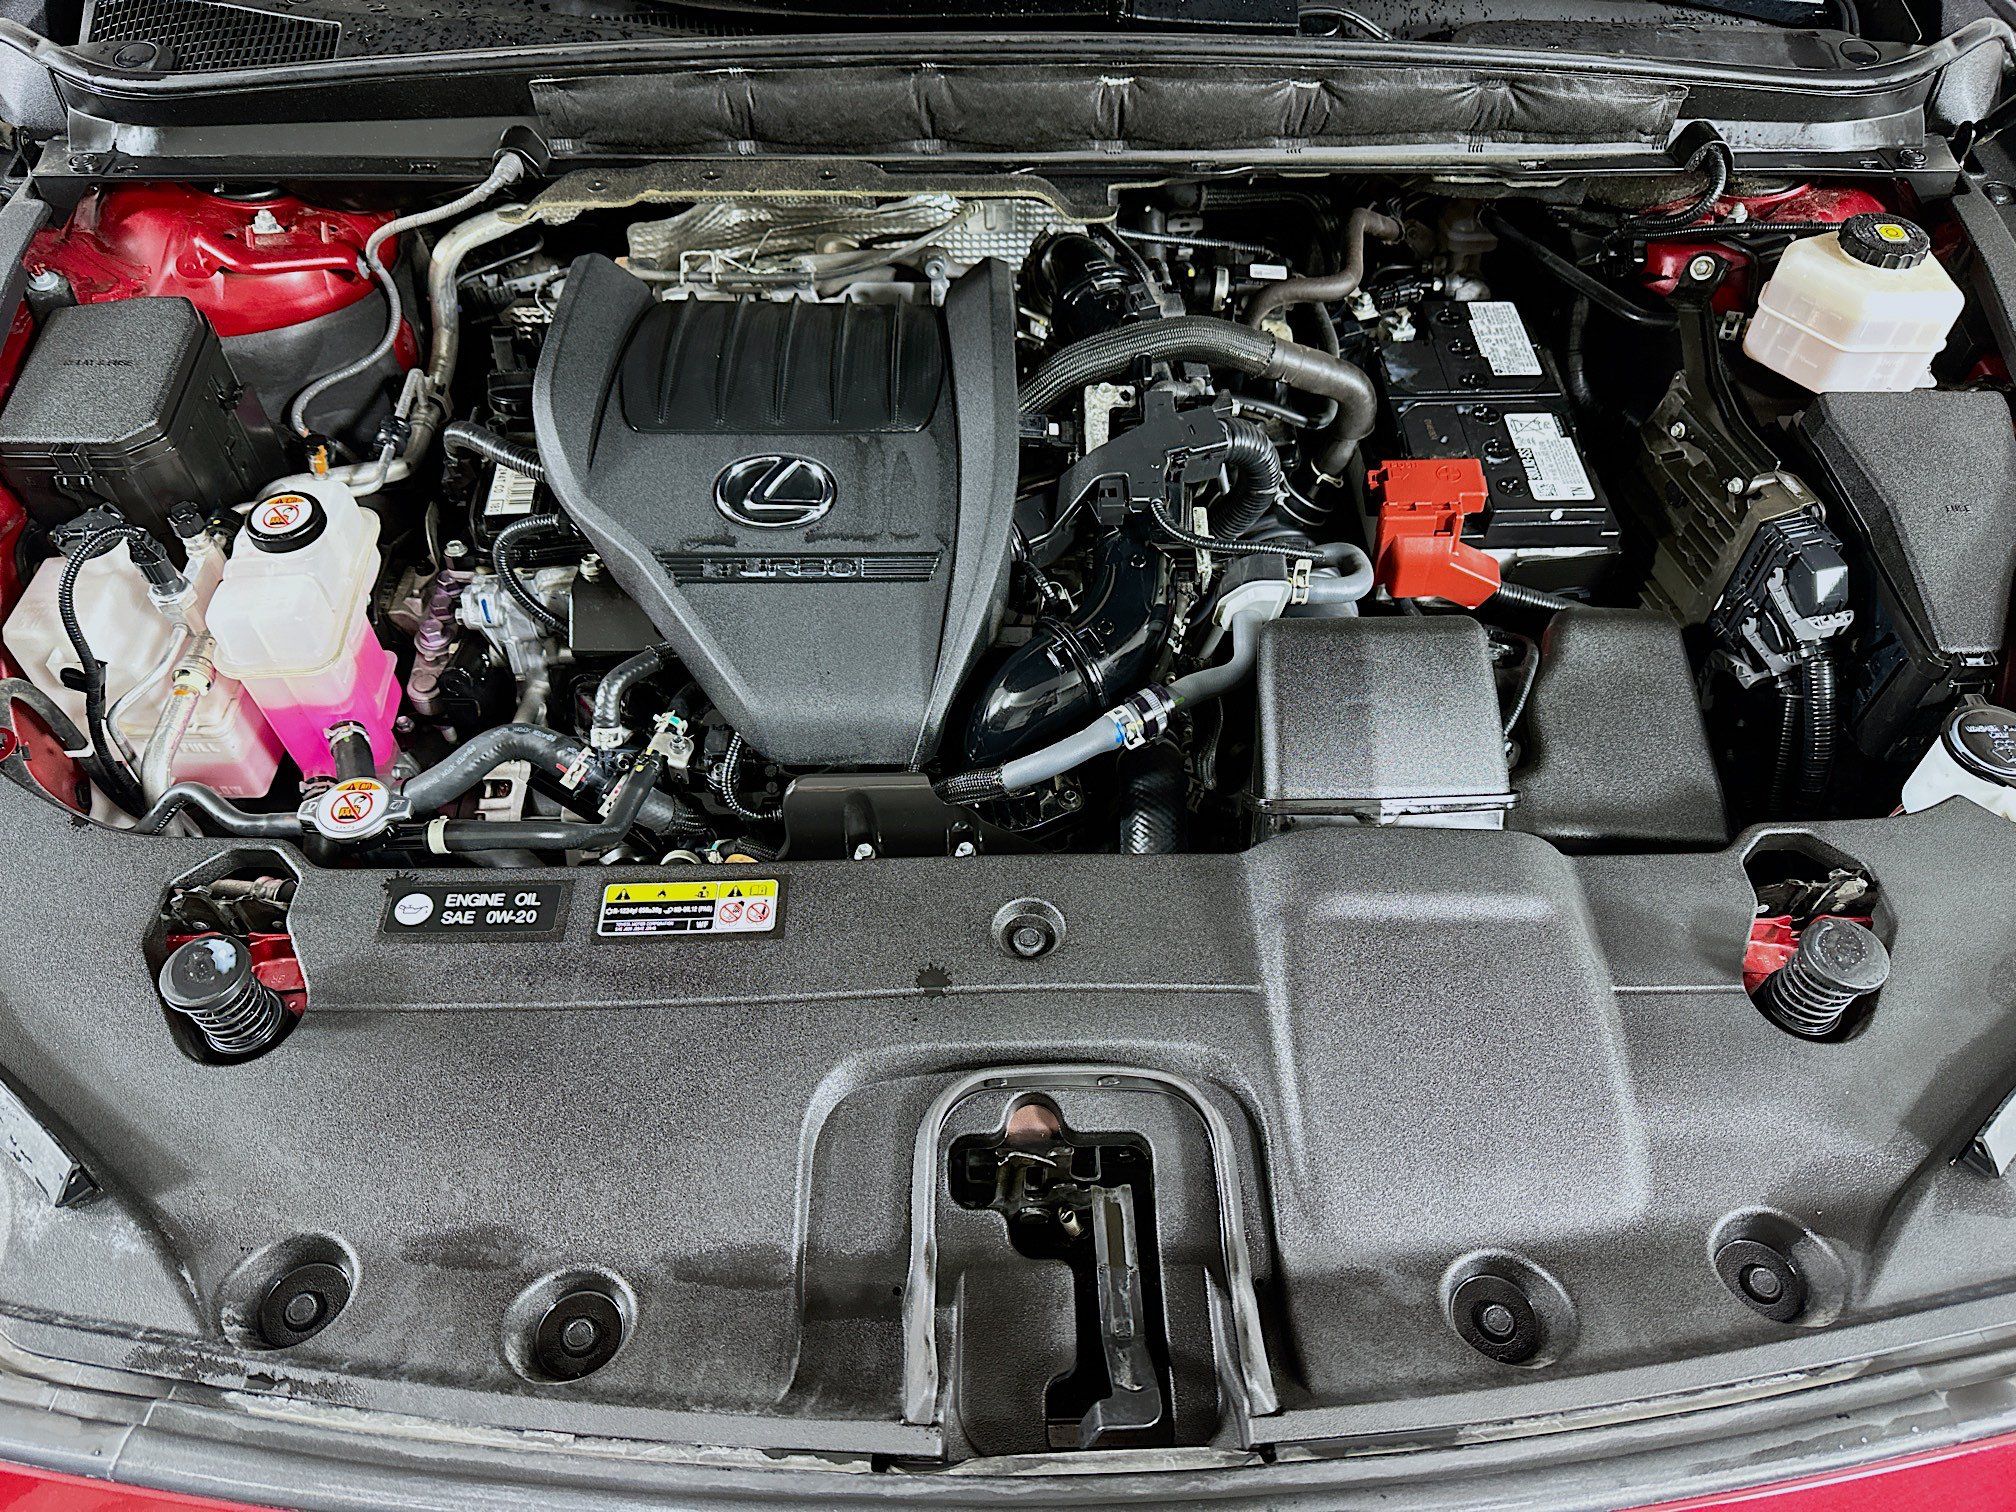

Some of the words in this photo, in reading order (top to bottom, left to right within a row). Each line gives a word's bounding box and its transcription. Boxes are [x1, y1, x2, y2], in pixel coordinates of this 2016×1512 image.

[704, 557, 858, 578] TURBO
[444, 892, 506, 908] ENGINE
[514, 892, 542, 907] OIL
[440, 910, 476, 925] SAE
[485, 909, 538, 925] 0W-20
